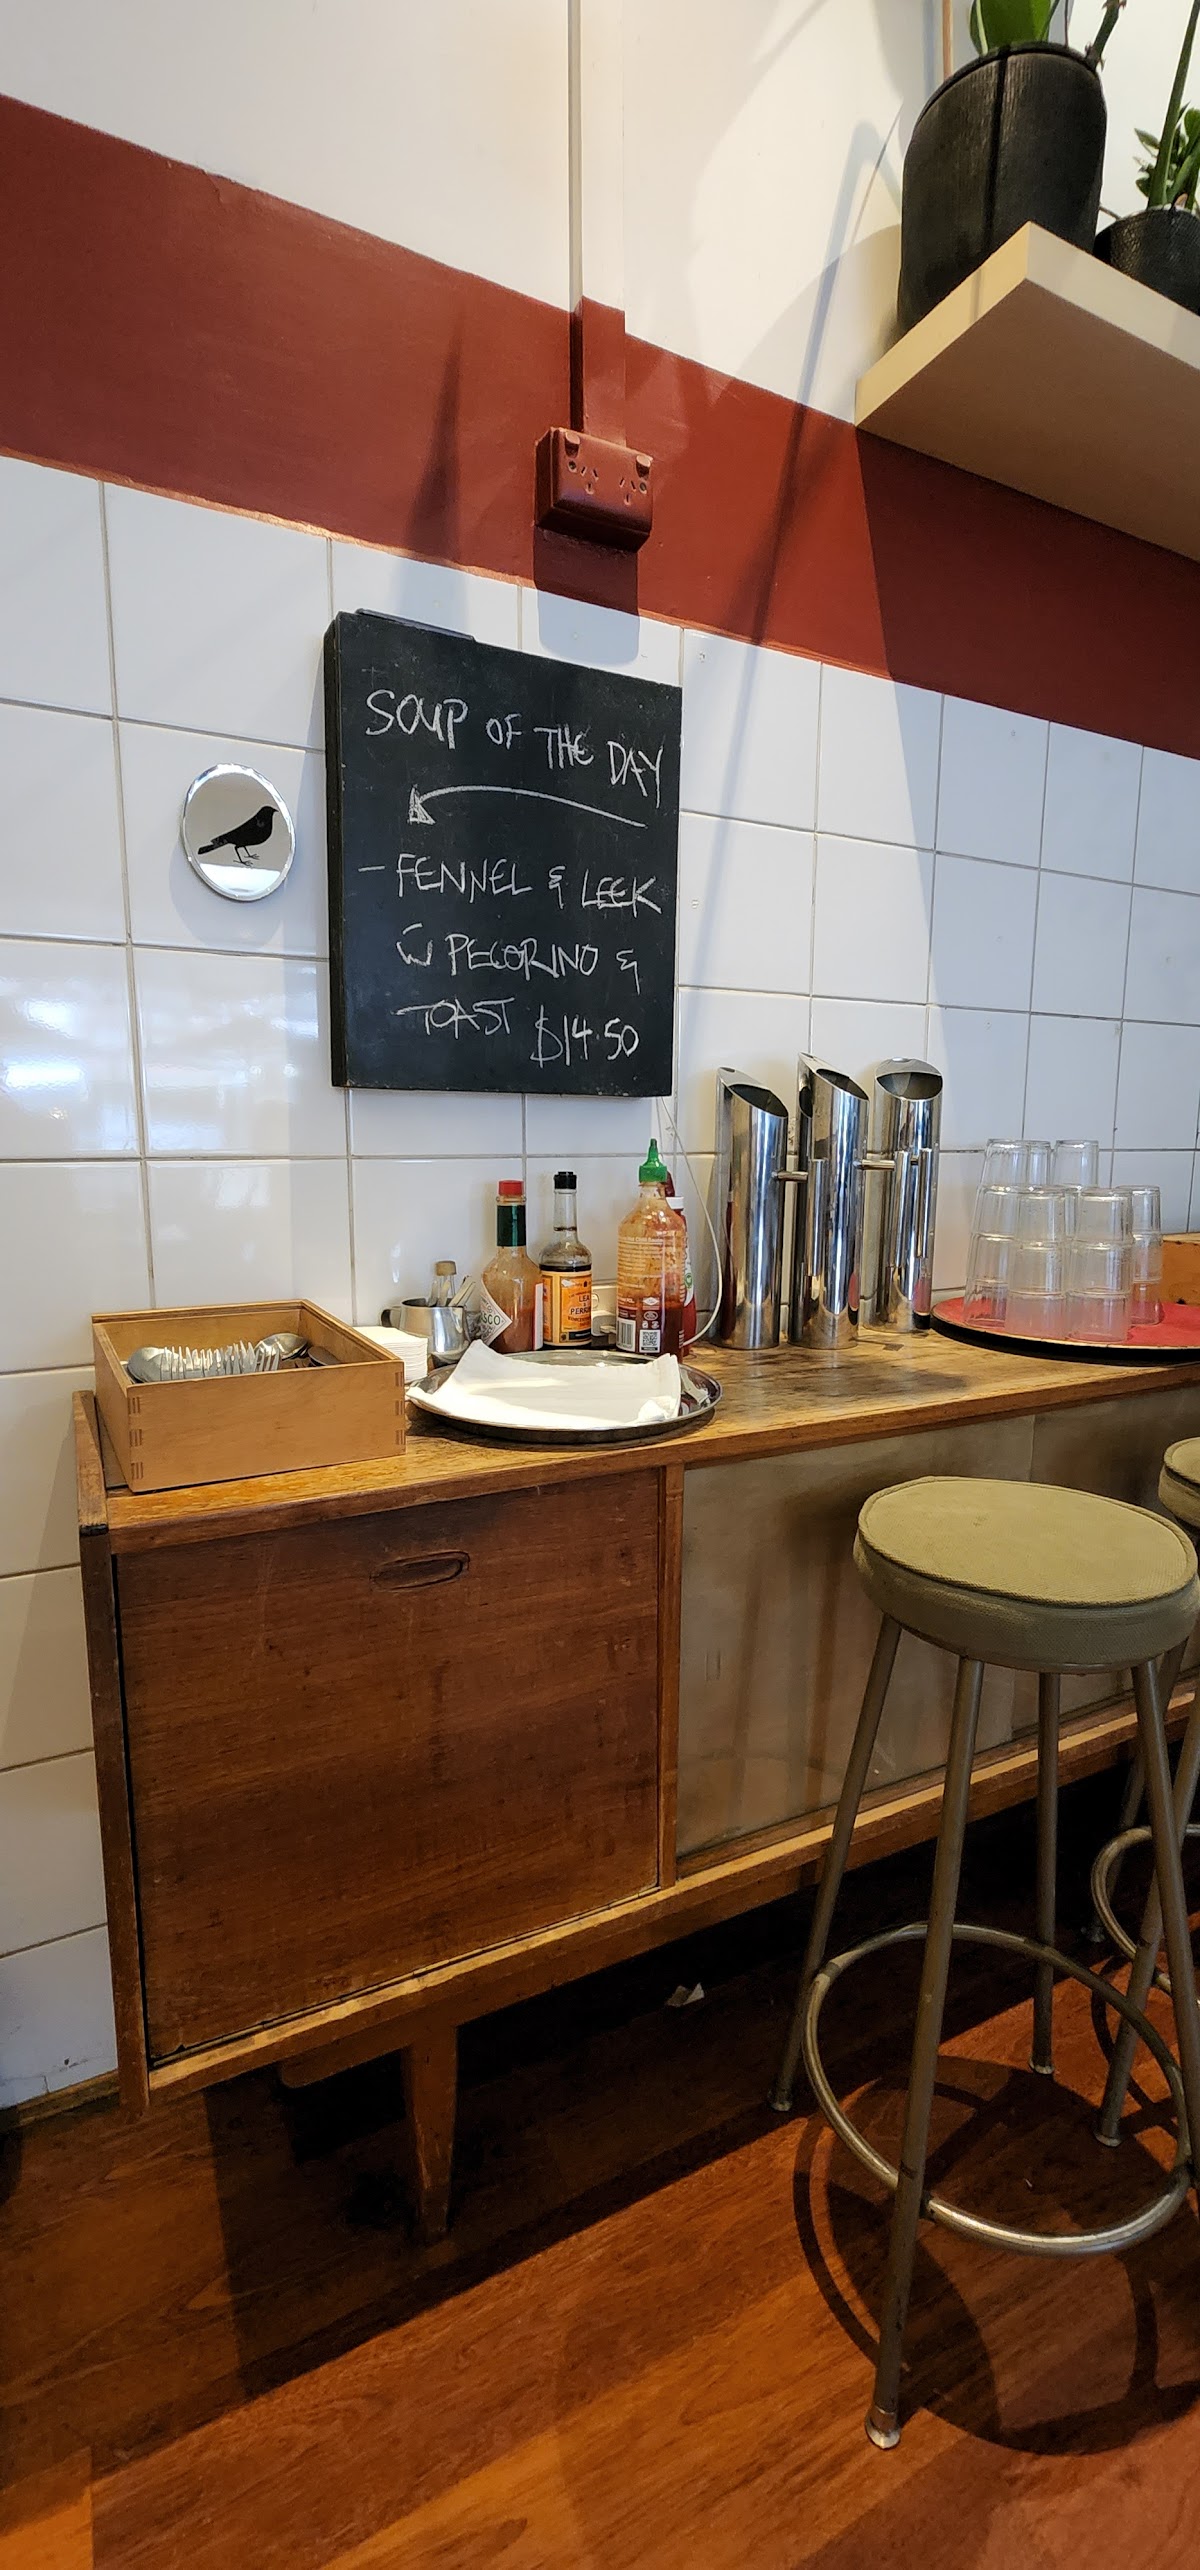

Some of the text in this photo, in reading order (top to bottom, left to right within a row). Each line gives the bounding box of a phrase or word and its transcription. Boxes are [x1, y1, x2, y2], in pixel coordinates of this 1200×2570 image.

[365, 689, 664, 808] SOUP OF THE DAY
[395, 853, 533, 904] FENNEL
[548, 865, 566, 910] &
[581, 869, 662, 918] LEEK
[444, 933, 599, 981] PECORINO
[616, 948, 640, 995] &
[392, 997, 640, 1068] TOAST $14.50
